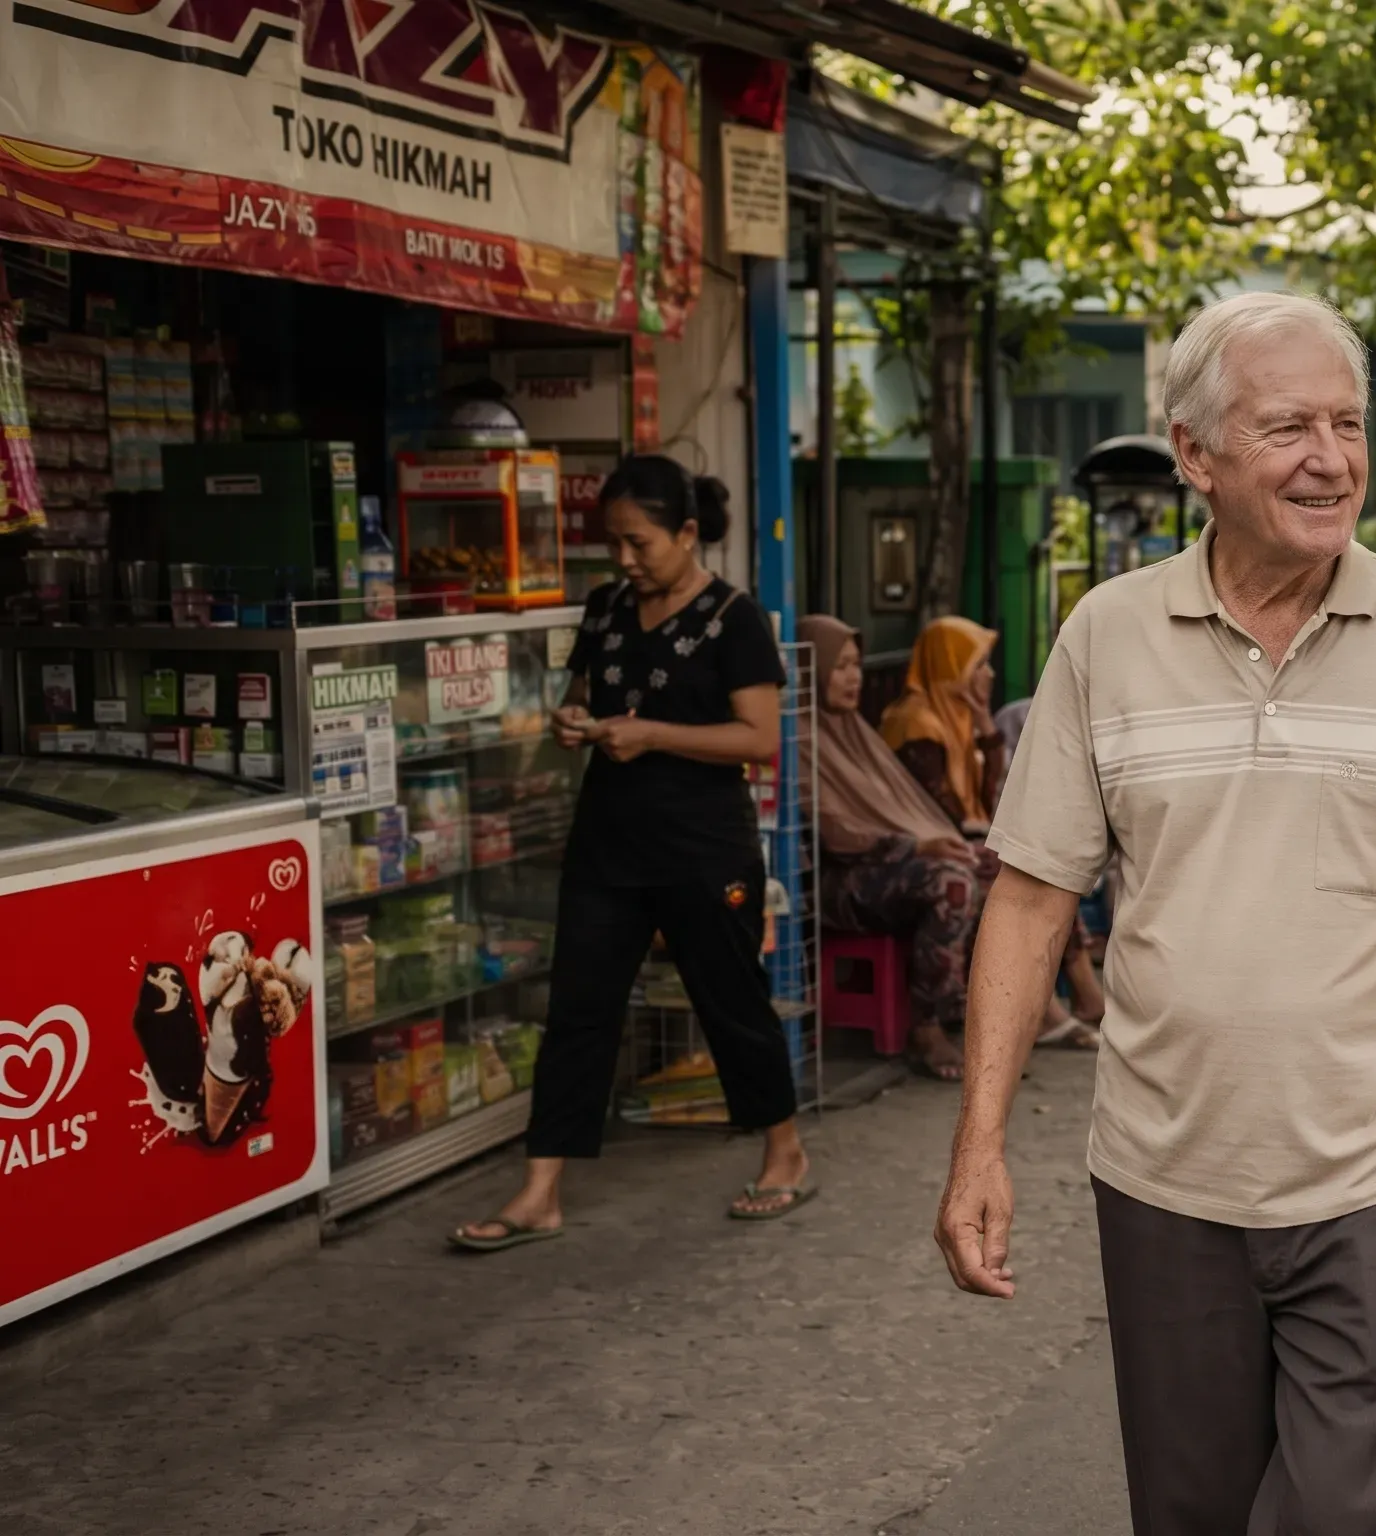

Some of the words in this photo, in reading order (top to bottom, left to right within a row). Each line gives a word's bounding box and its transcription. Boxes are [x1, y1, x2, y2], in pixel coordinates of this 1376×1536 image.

[273, 104, 364, 168] TOKO
[371, 132, 492, 202] HIKMAH
[224, 192, 288, 231] JAZY
[454, 642, 508, 673] ULANG
[314, 670, 397, 707] HIKMAH
[0, 1114, 88, 1175] ALL'S
